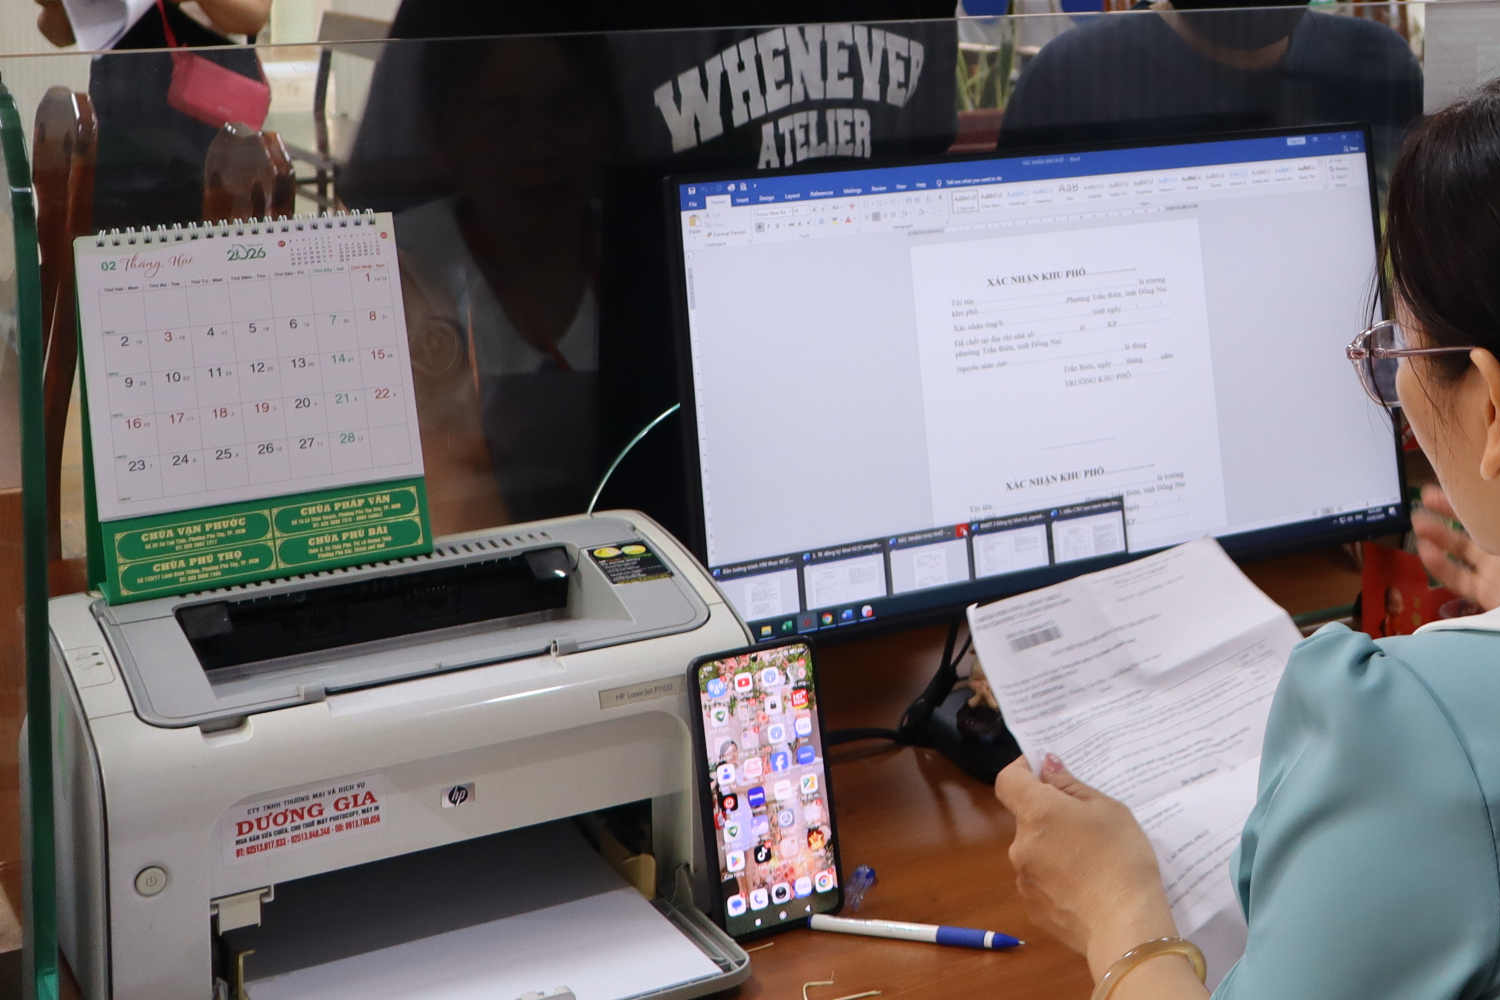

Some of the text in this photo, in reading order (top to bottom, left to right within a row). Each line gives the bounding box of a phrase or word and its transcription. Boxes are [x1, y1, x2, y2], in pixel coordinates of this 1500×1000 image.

[757, 108, 871, 170] ATELIER
[101, 261, 116, 271] 02
[120, 253, 161, 278] Tháng
[365, 273, 370, 282] 1
[987, 275, 1008, 287] XÁC
[1011, 273, 1039, 285] NHẬN
[1042, 271, 1063, 281] KHU
[120, 311, 377, 347] 2 3 4 5 6 7 8
[124, 349, 385, 388] 9 10 11 12 13 14 15
[126, 388, 390, 429] 16 17 18 19 20 21 22
[128, 432, 355, 472] 23 24 25 26 27 28
[1005, 478, 1026, 491] XÁC
[1029, 474, 1058, 488] NHẬN
[1060, 470, 1082, 482] KHU
[300, 494, 390, 516] CHÙA PHÁP VÂN
[141, 517, 246, 542] CHÙA VẠN PHƯỚC
[308, 526, 388, 546] CHÙA PHÚ BÀI
[153, 550, 242, 572] CHÙA PHÚ THỌ
[615, 692, 625, 700] HP
[247, 807, 259, 815] CTY
[263, 802, 281, 811] TNHH
[284, 795, 310, 806] THƯƠNG
[328, 787, 336, 795] VÀ
[339, 785, 354, 794] DỊCH
[449, 785, 468, 806] hp
[236, 791, 378, 836] DƯƠNG GIA
[291, 824, 301, 832] CHO
[303, 820, 316, 829] THUÊ
[317, 817, 328, 825] MÁY
